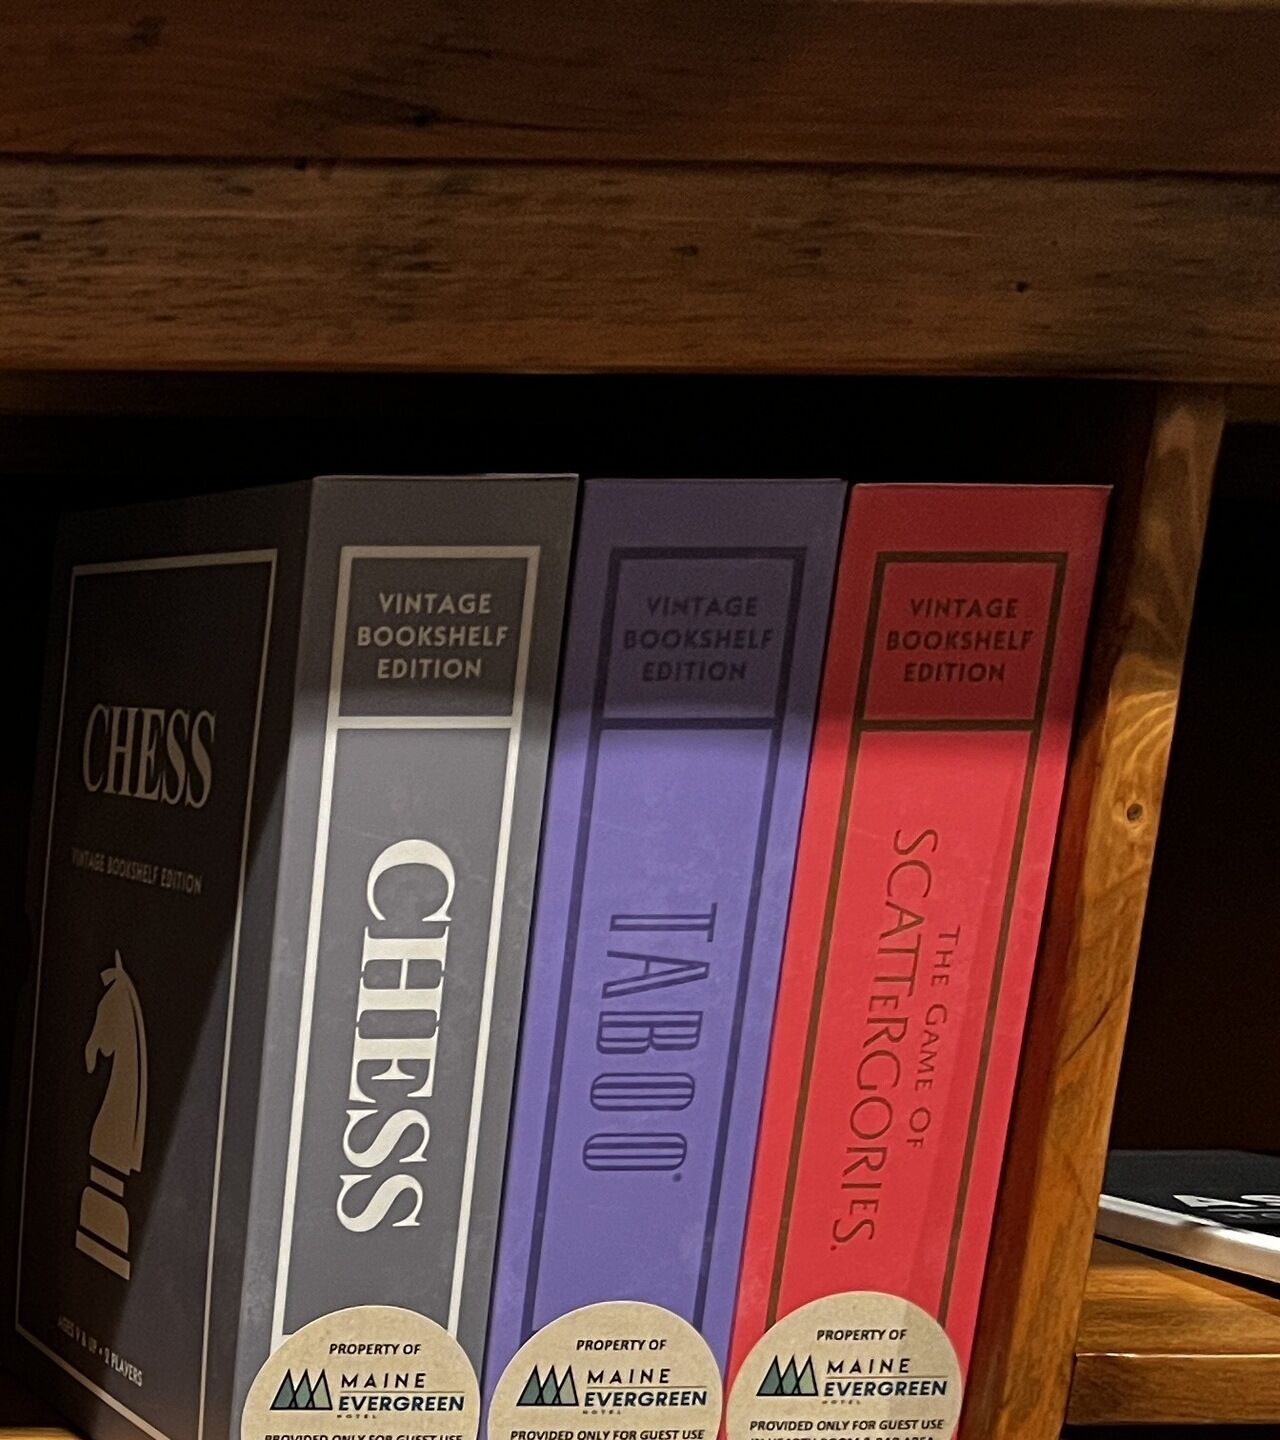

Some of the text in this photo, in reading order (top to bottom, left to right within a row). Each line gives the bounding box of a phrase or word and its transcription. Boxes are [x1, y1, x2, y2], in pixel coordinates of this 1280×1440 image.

[378, 593, 491, 615] VINTAGE
[646, 597, 757, 618] VINTAGE
[910, 598, 1019, 619] VINTAGE
[357, 626, 508, 647] BOOKSHELF
[623, 629, 773, 651] BOOKSHELF
[886, 630, 1033, 652] BOOKSHELF
[377, 658, 482, 679] EDITION
[641, 661, 747, 682] EDITION
[904, 662, 1005, 683] EDITION
[82, 703, 216, 809] CHESS
[70, 847, 203, 895] VINTAGE BOOKSHELF EDITION
[336, 838, 455, 1233] CHESS
[583, 901, 718, 1172] TABOO
[832, 828, 939, 1244] SCATTERGORIES
[906, 925, 961, 1149] THE GAME OF
[576, 1339, 667, 1351] PROPERTY OF
[816, 1329, 907, 1341] PROPERTY OF
[329, 1343, 421, 1355] PROPERTY OF
[587, 1368, 671, 1384] MAINE
[826, 1358, 911, 1374] MAINE
[341, 1373, 426, 1388] MAINE
[823, 1381, 947, 1397] EVERGREEN
[338, 1396, 465, 1412] EVERGREEN
[584, 1391, 707, 1407] EVERGREEN
